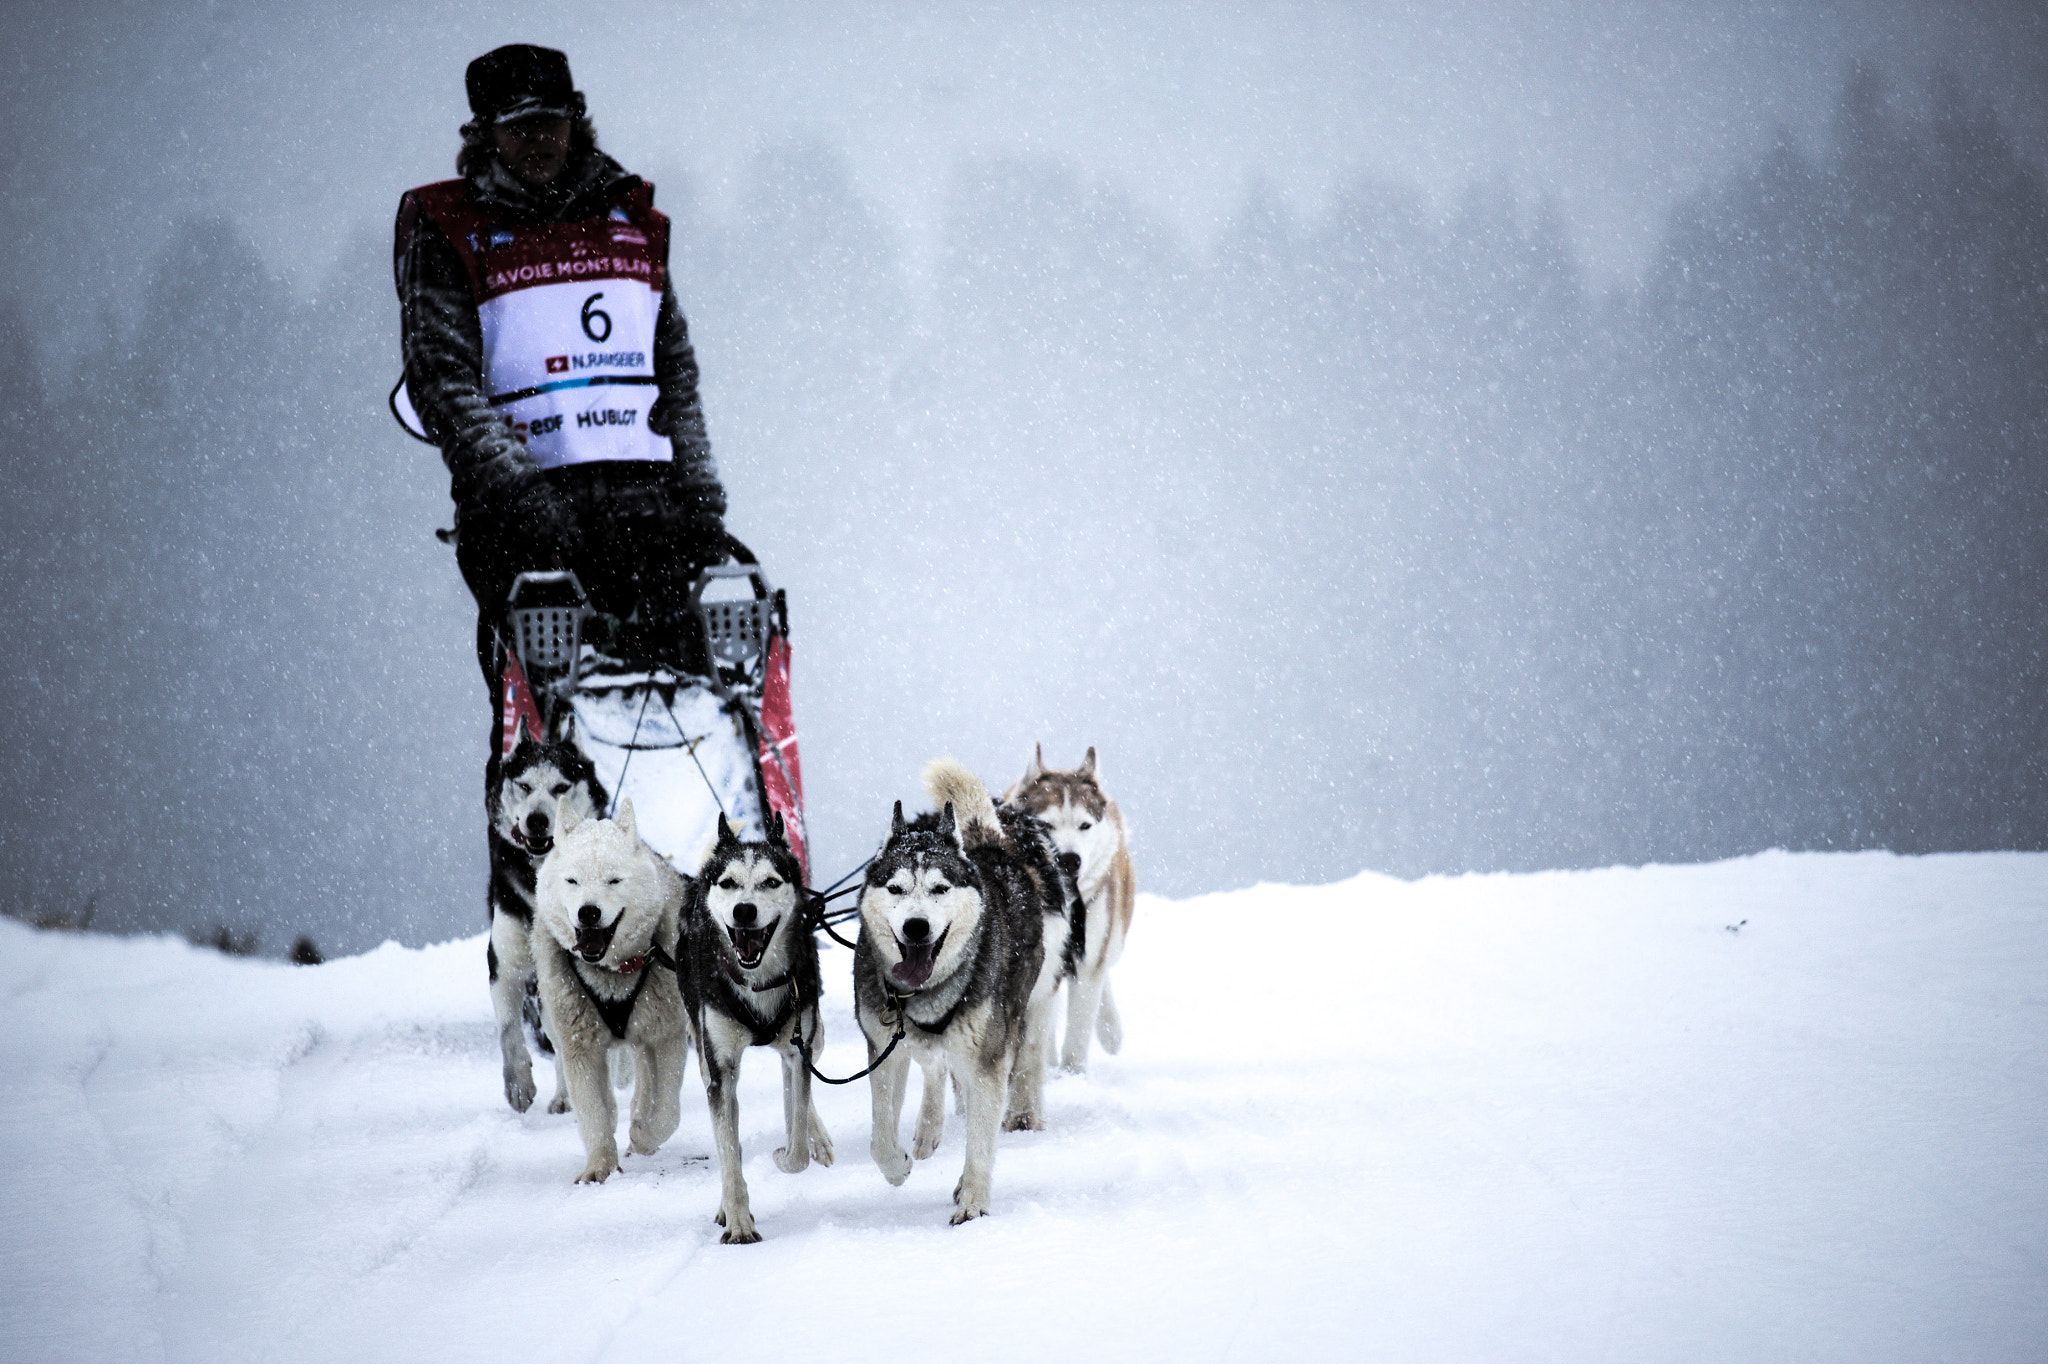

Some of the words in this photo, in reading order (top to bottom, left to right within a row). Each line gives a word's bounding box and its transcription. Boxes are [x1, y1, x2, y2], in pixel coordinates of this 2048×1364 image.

[486, 262, 553, 290] SAVOIE
[557, 257, 609, 276] MONT
[581, 292, 613, 343] 6
[576, 409, 637, 429] HUBLOT
